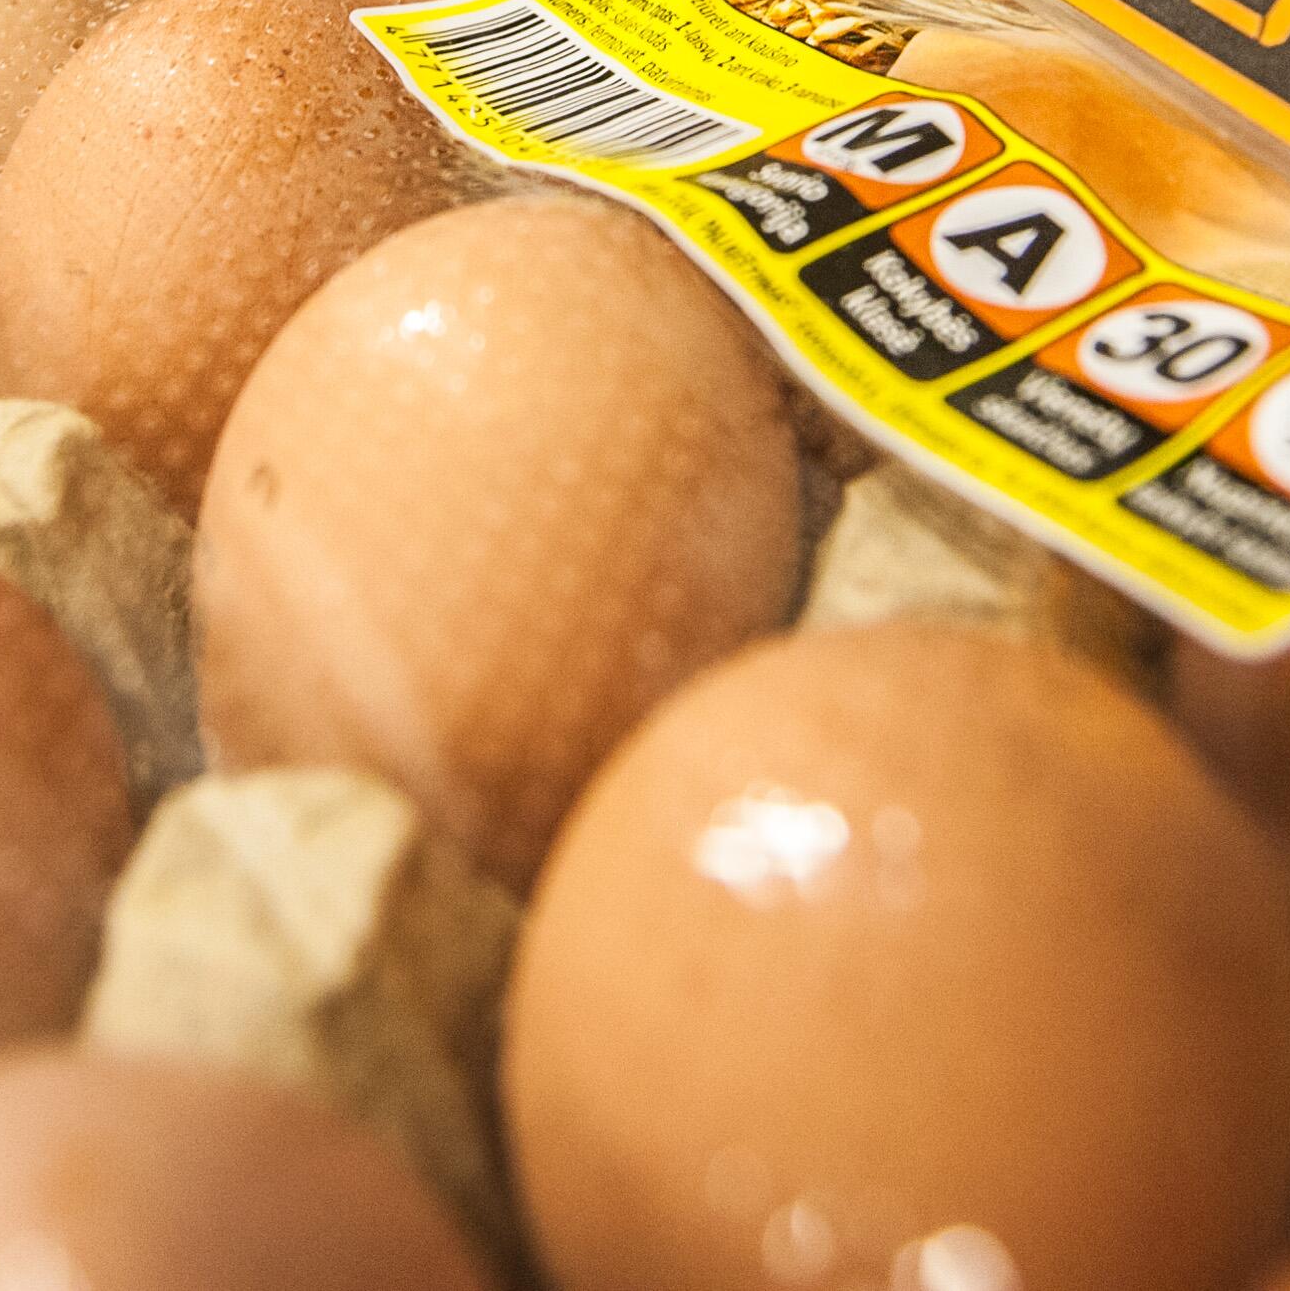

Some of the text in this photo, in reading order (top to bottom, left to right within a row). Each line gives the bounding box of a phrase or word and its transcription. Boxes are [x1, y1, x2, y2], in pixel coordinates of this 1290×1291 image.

[724, 26, 754, 45] ant
[812, 107, 957, 174] M
[942, 211, 1067, 296] A
[1093, 313, 1250, 383] 30
